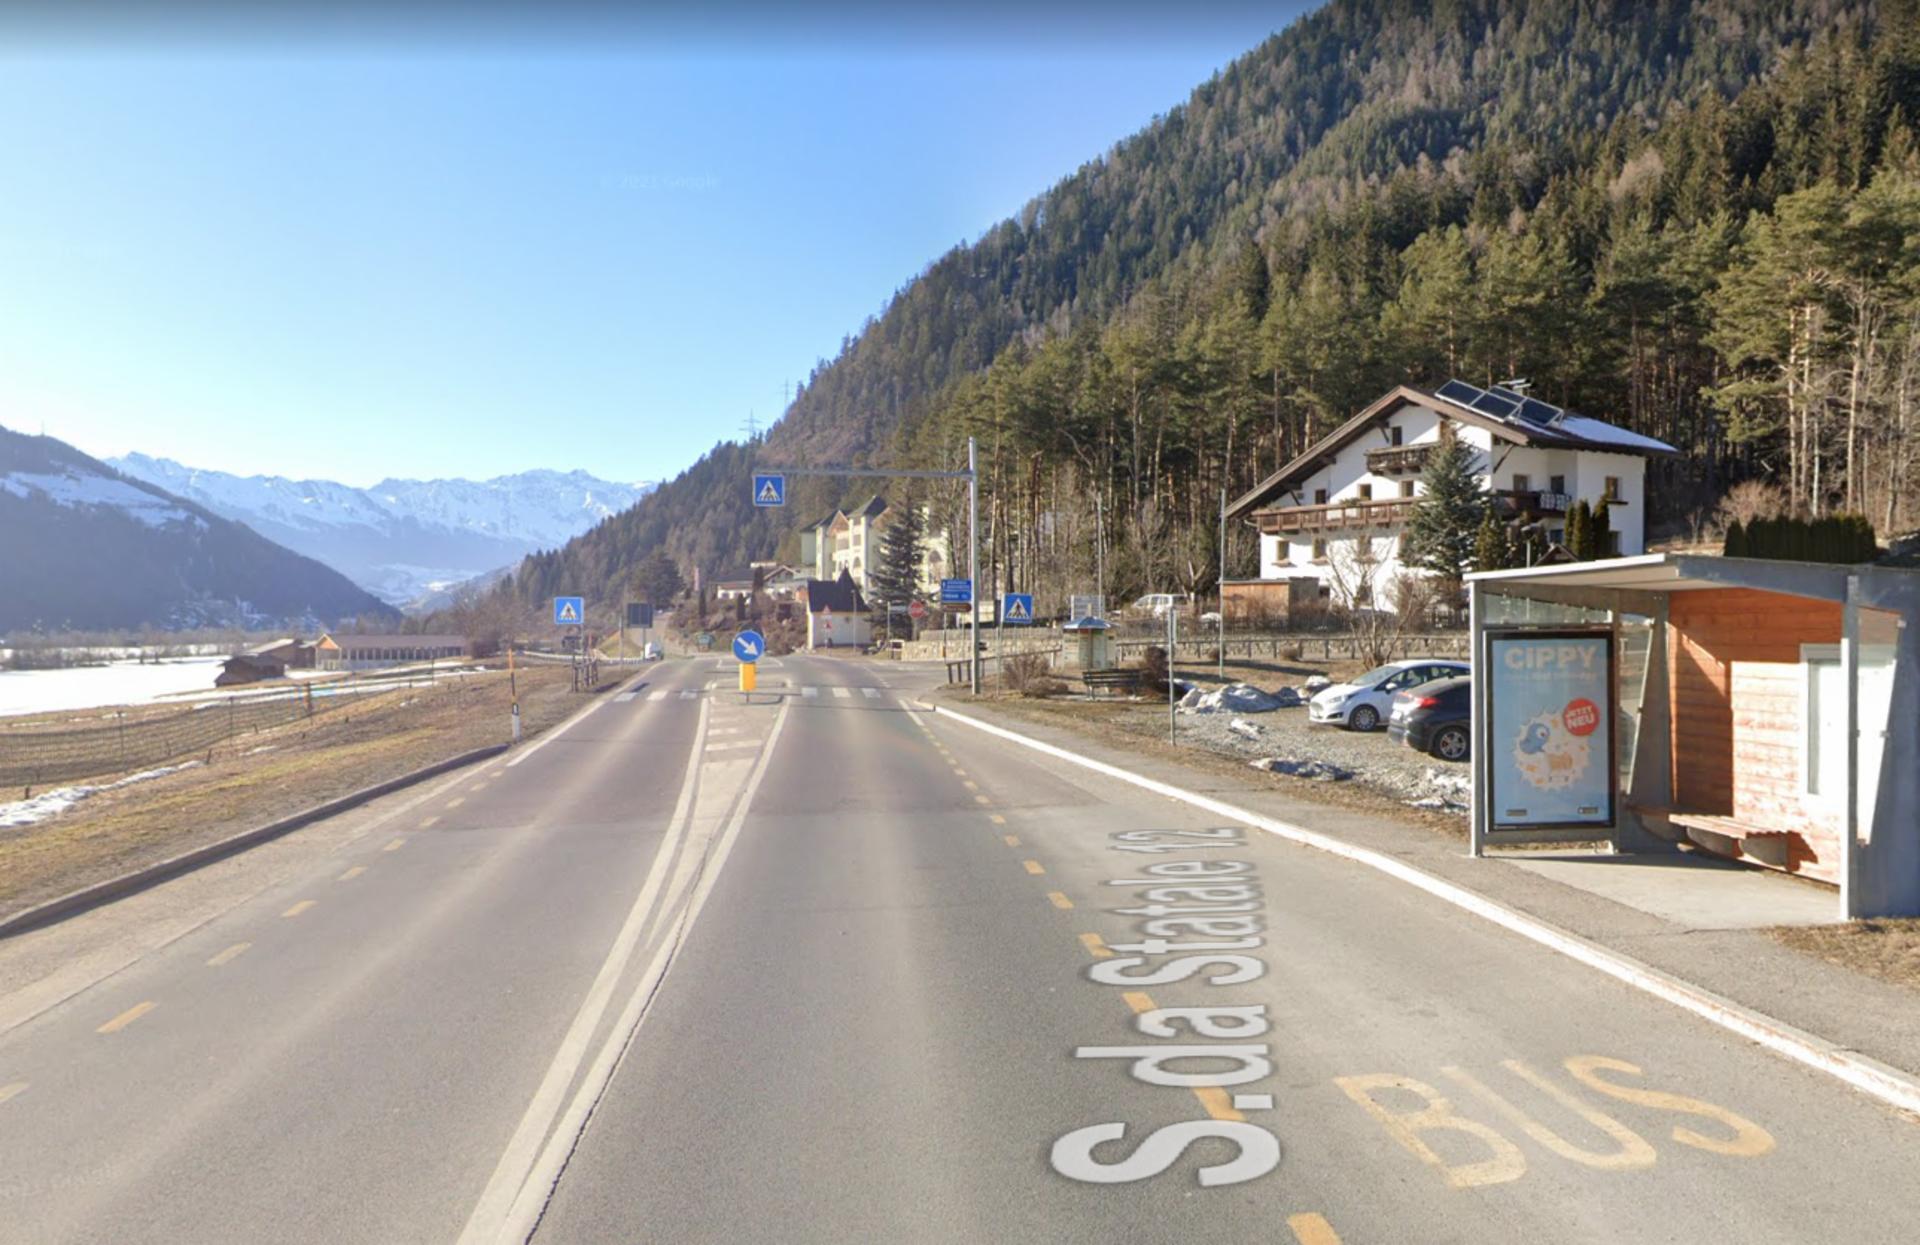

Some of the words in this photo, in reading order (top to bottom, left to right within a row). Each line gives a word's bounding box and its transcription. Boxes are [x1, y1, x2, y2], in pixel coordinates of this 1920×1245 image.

[1504, 645, 1597, 669] CIPPY
[1567, 712, 1595, 729] NEU
[1333, 1055, 1777, 1190] BUS
